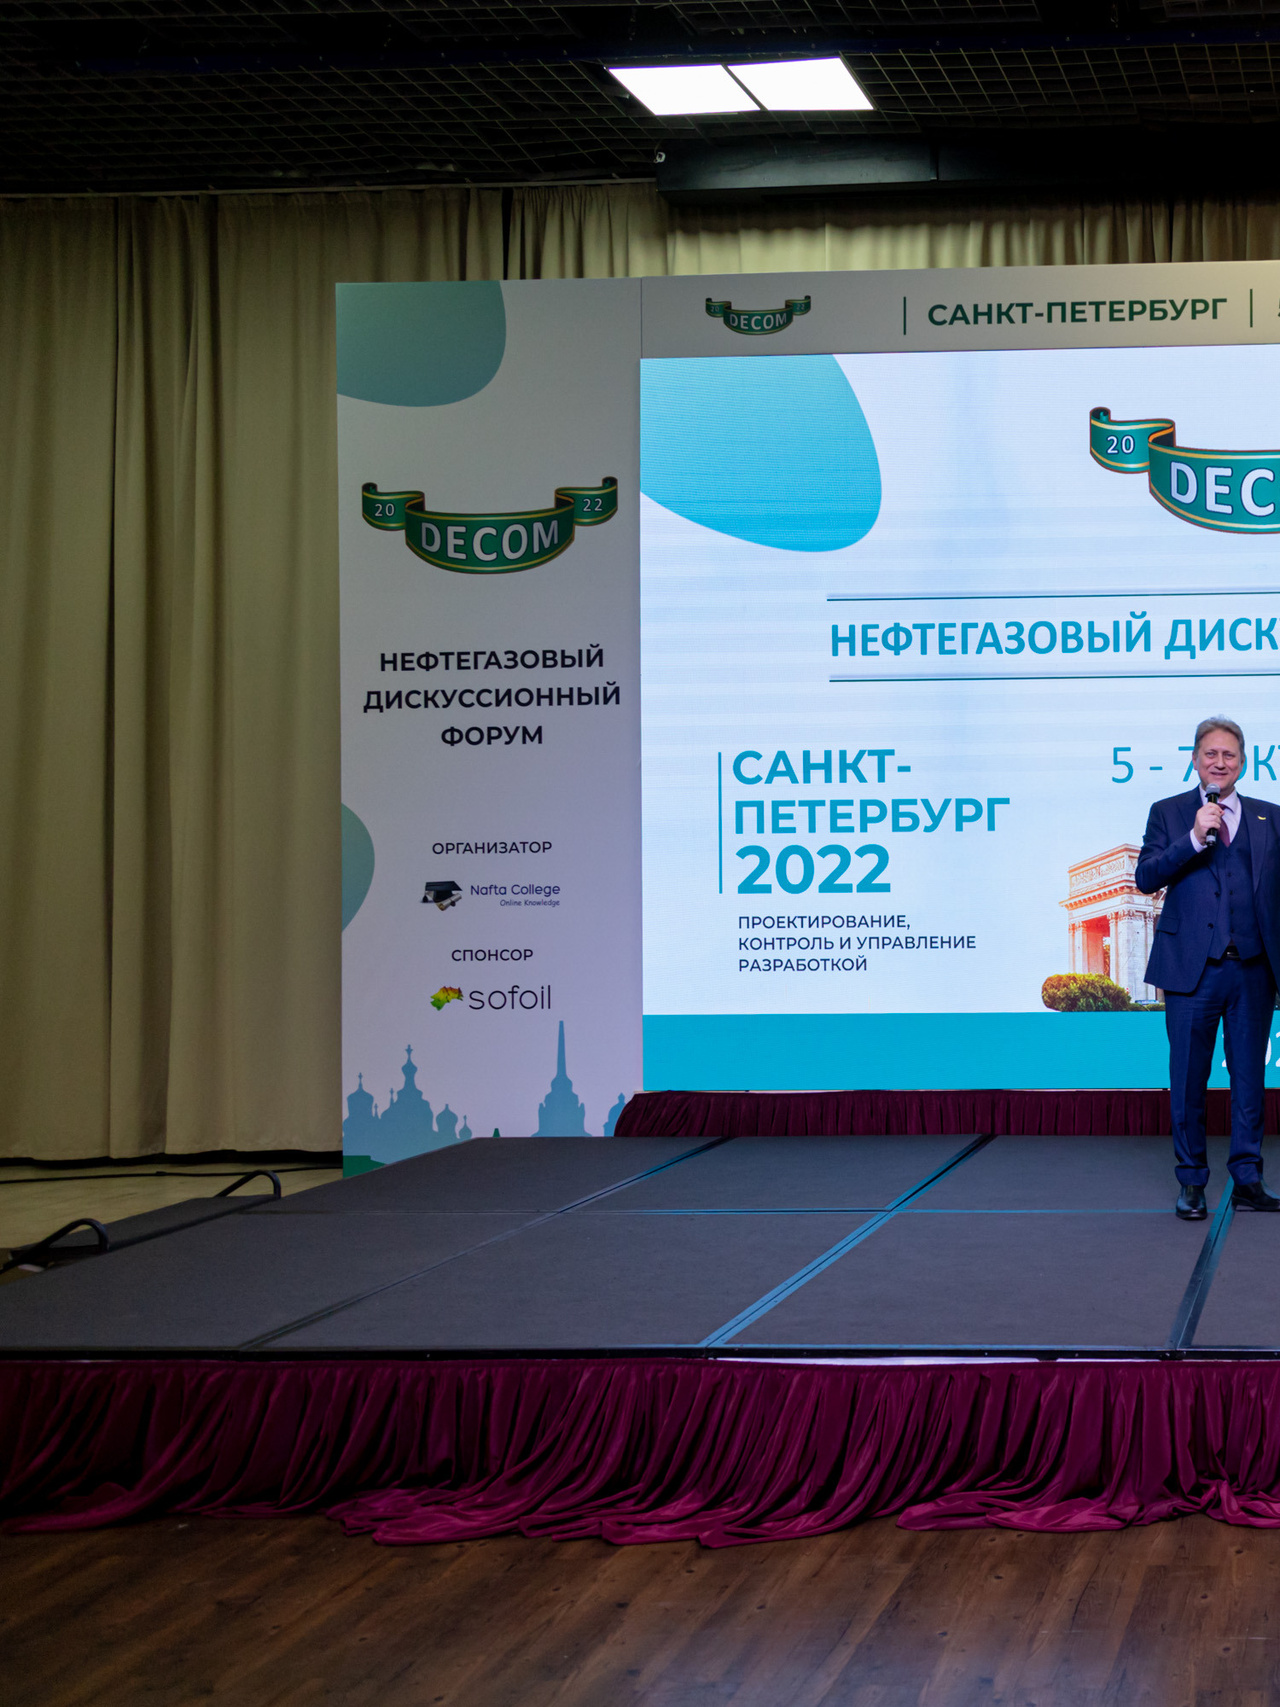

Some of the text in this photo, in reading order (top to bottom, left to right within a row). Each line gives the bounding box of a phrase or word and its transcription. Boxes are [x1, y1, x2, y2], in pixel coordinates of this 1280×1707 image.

[729, 312, 787, 330] DECOM
[927, 297, 1228, 327] САНКТ-ПЕТЕРБУРГ
[1106, 435, 1135, 454] 20
[374, 498, 603, 561] 20 DECOM 22
[831, 610, 1152, 657] НЕФТЕГАЗОВЫЙ
[380, 643, 604, 672] НЕФТЕГАЗОВЫЙ
[362, 680, 621, 714] ДИСКУССИОННЫЙ
[440, 725, 543, 748] ФОРУМ
[732, 748, 912, 786] САНКТ-
[1111, 746, 1134, 784] 5
[734, 797, 1011, 835] ПЕТЕРБУРГ
[431, 840, 553, 855] ОРГАНИЗАТОР
[735, 843, 891, 895] 2022
[470, 883, 561, 898] Nafta College
[499, 899, 560, 908] Online Knowledge
[738, 914, 911, 931] ПРОЕКТИРОВАНИЕ,
[451, 948, 534, 962] СПОНСОР
[738, 935, 977, 951] КОНТРОЛЬ И УПРАВЛЕНИЕ
[738, 954, 868, 973] РАЗРАБОТКОЙ
[468, 984, 551, 1011] sofoil
